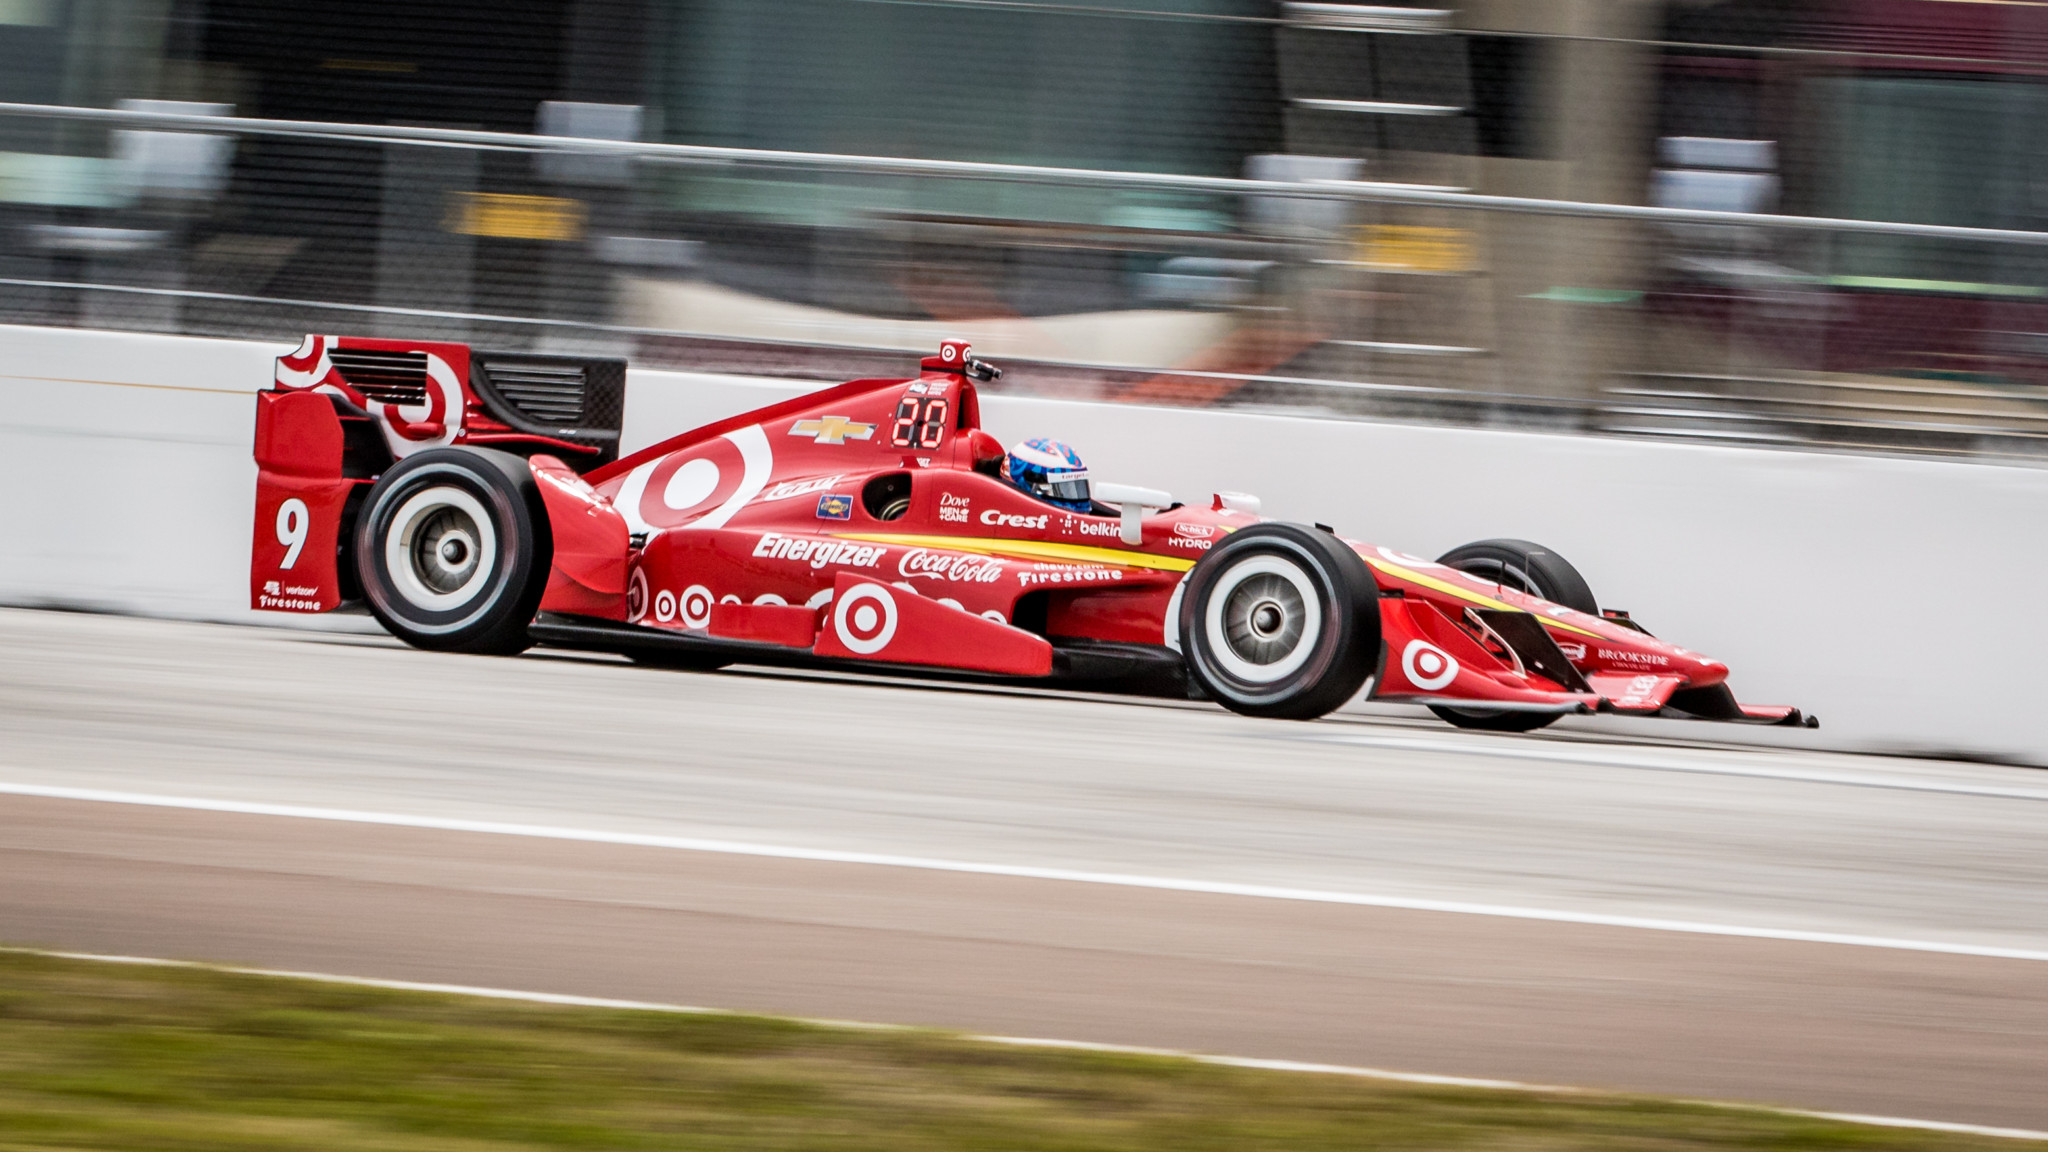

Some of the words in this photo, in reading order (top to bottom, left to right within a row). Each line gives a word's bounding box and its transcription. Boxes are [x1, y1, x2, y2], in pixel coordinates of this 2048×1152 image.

[892, 397, 948, 449] 20
[940, 492, 970, 507] Dove
[940, 507, 960, 515] MEN
[980, 509, 1049, 529] Crest
[275, 498, 310, 570] 9
[1080, 520, 1121, 537] belkin
[1178, 524, 1210, 536] Schick
[752, 532, 887, 569] Energizer
[1168, 536, 1213, 550] HYDRO
[1017, 570, 1123, 587] Firestone
[259, 595, 321, 611] Firestone
[1598, 648, 1669, 665] BROOKSIDE
